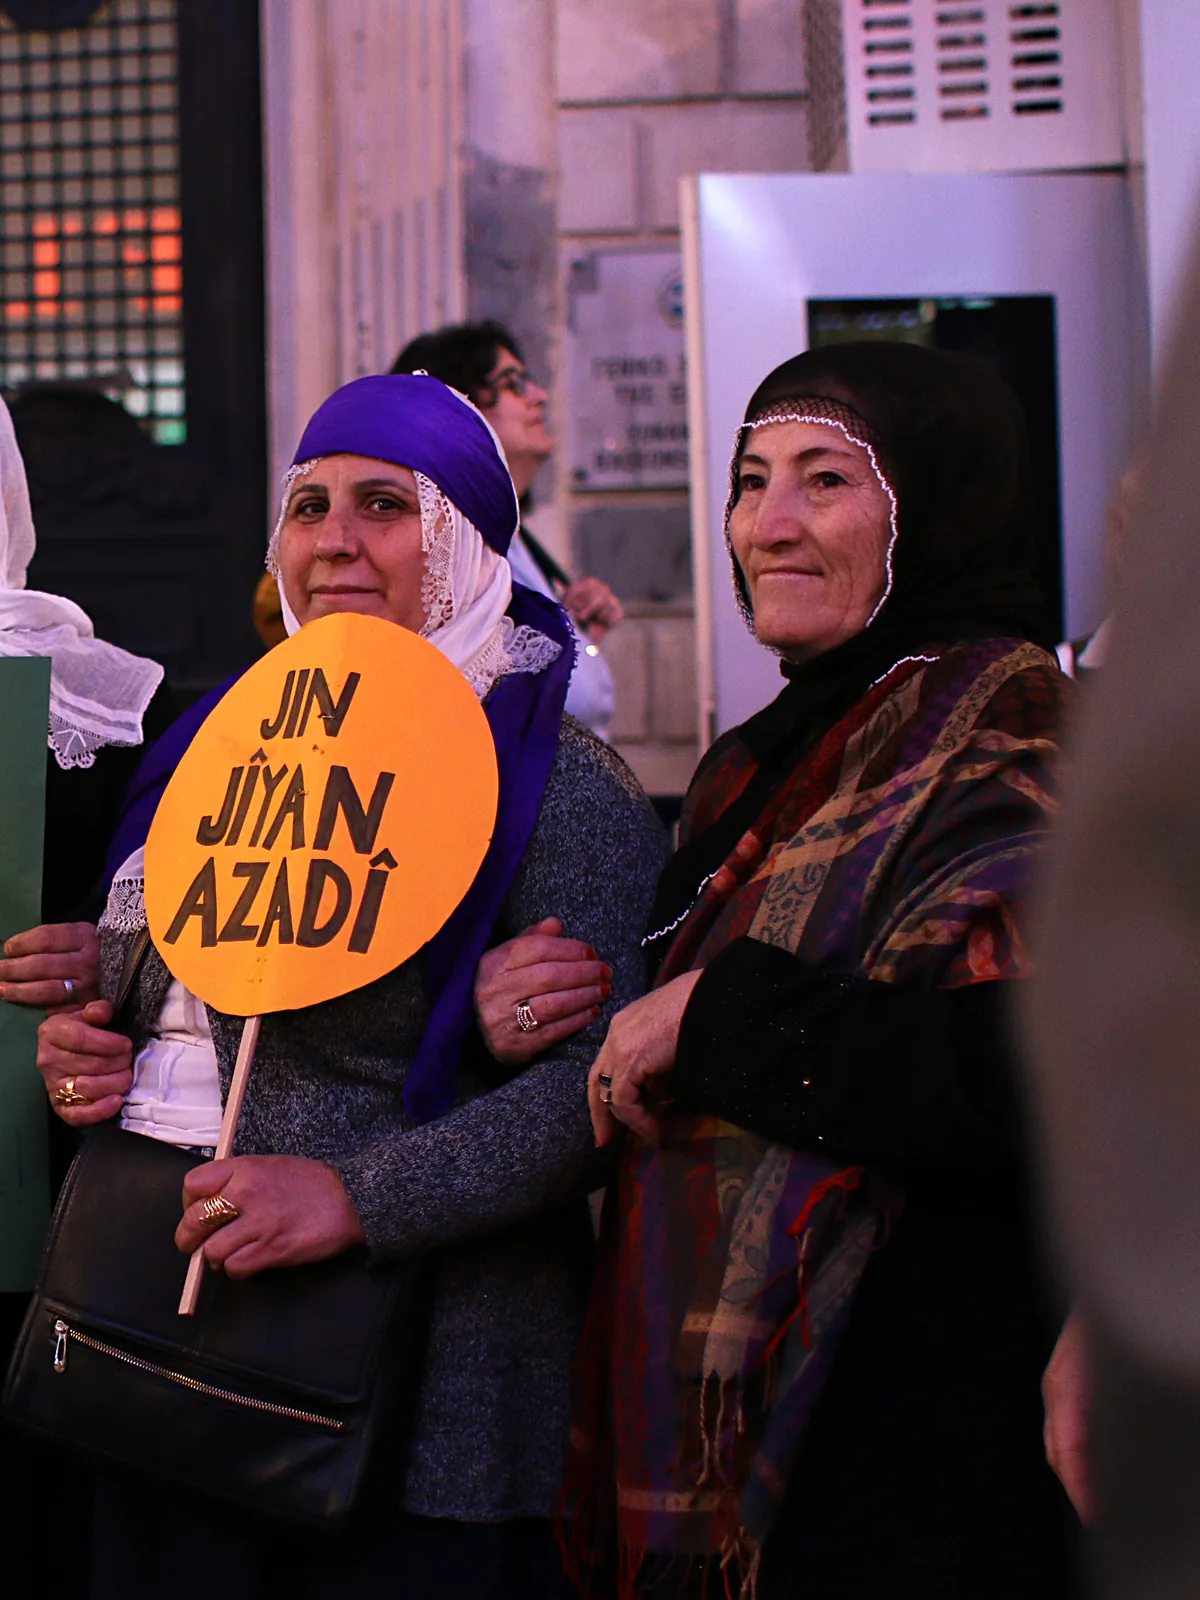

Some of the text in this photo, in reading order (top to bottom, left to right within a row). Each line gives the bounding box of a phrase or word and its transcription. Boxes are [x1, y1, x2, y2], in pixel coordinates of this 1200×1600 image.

[260, 668, 361, 740] JIN
[196, 748, 396, 855] JÎYAN
[163, 847, 399, 954] AZADÎ
